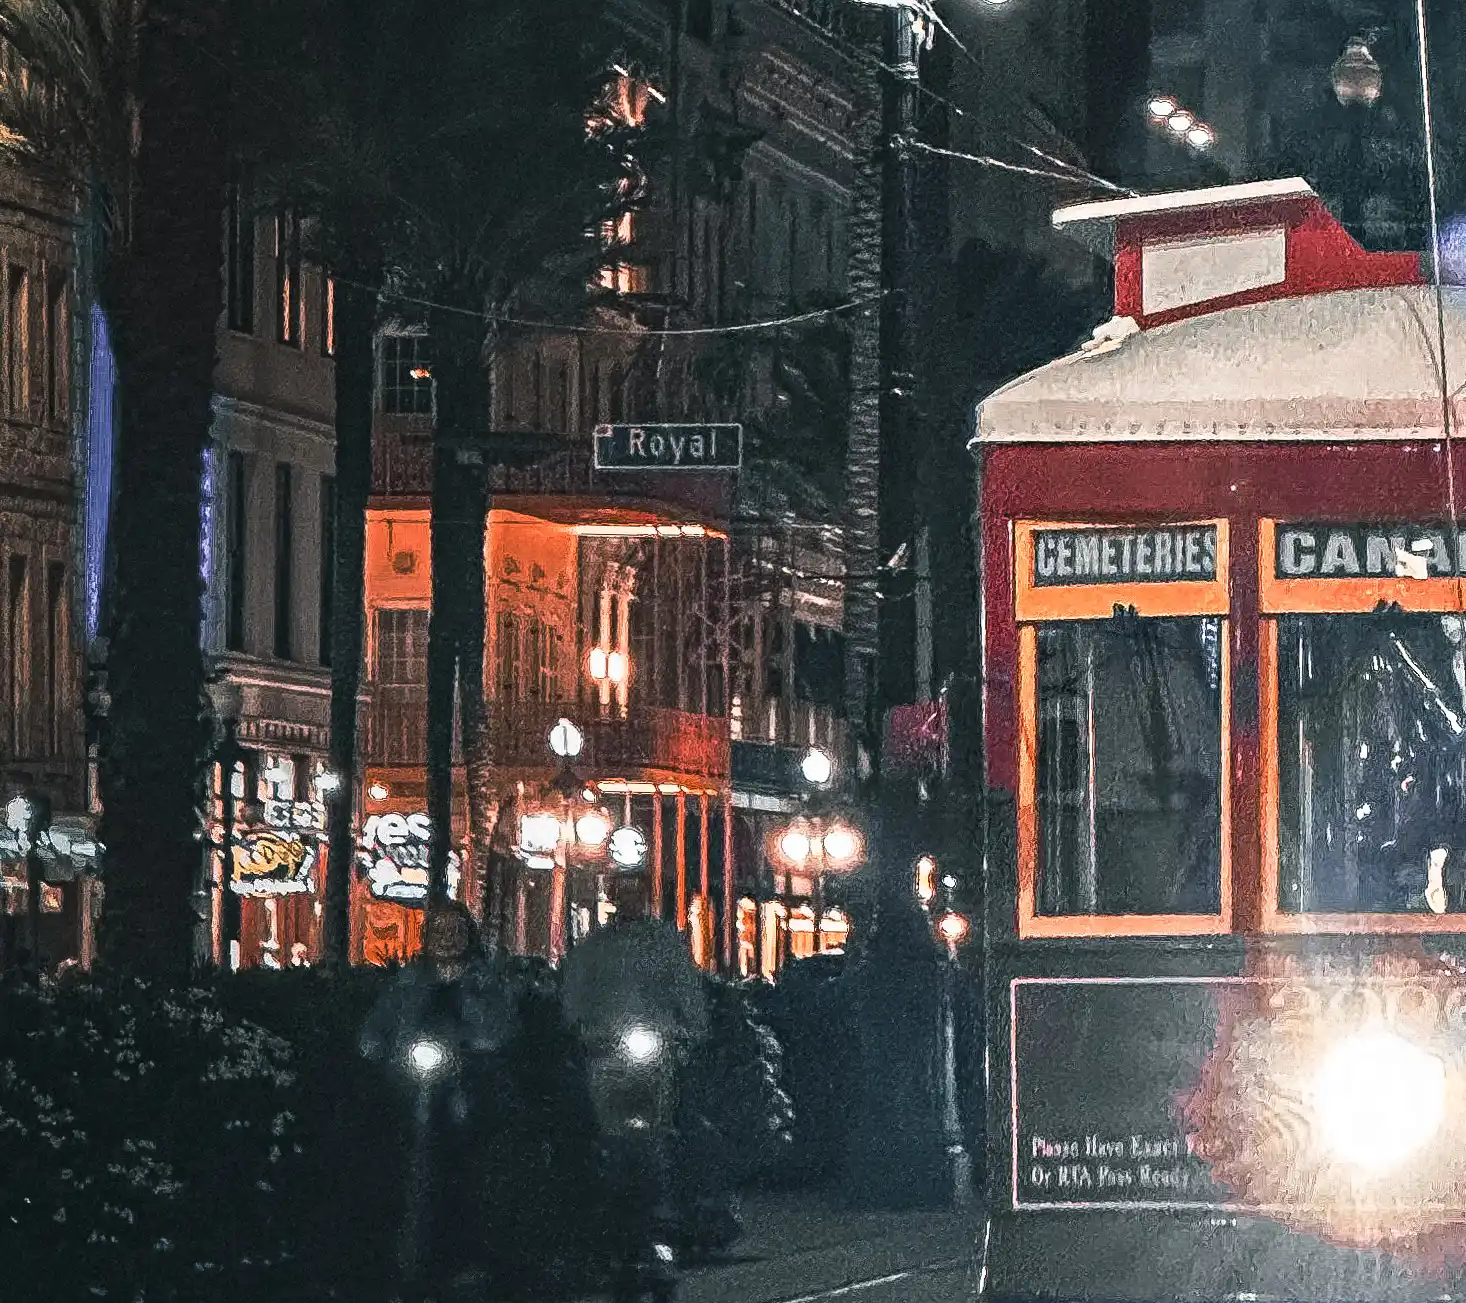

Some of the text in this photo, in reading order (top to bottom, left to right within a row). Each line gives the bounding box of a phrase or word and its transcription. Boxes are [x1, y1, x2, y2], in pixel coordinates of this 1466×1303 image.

[629, 427, 717, 465] Royal
[1037, 530, 1217, 576] CEMETERIES
[1031, 1133, 1080, 1158] Please
[1085, 1133, 1125, 1158] Have
[1131, 1133, 1179, 1158] Exact
[1031, 1164, 1191, 1190] Or RTA Pass Ready
